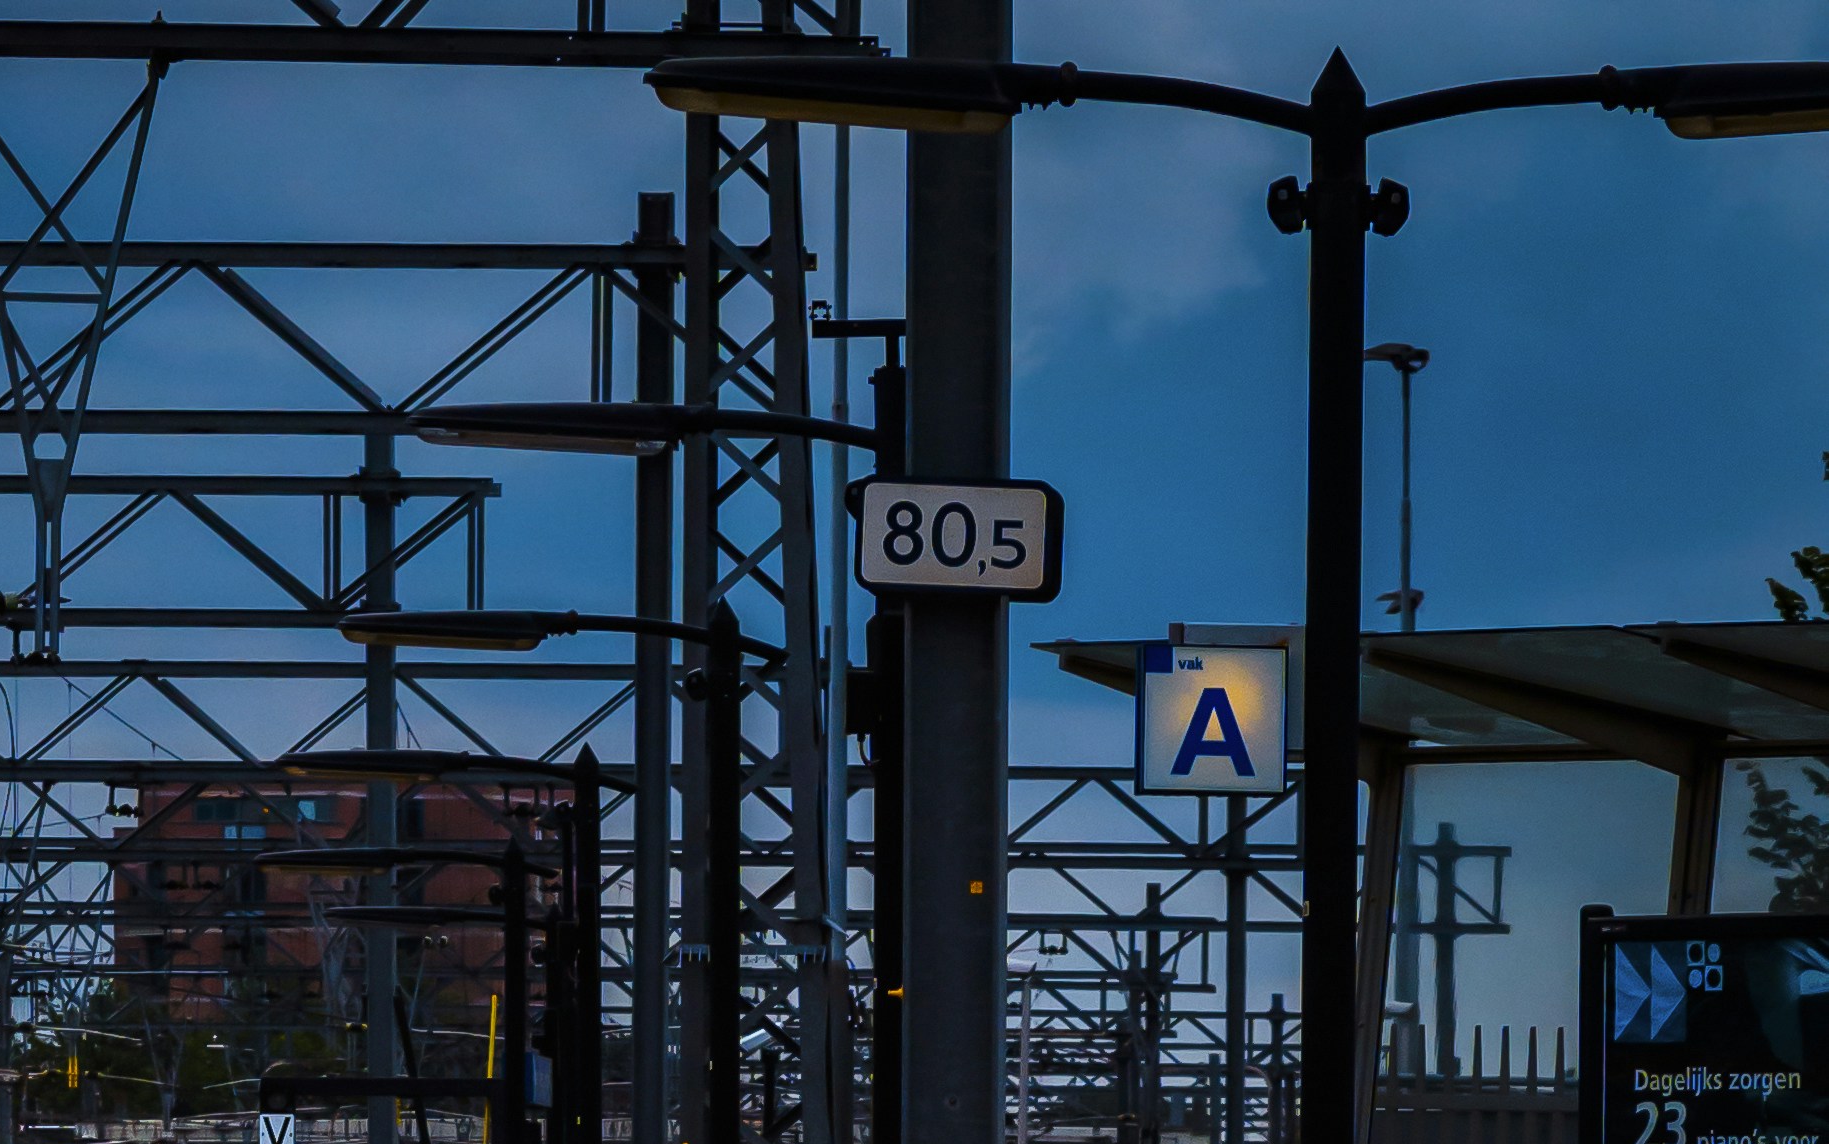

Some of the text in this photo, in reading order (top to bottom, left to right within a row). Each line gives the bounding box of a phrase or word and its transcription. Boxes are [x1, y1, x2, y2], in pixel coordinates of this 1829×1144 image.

[882, 500, 1027, 576] 80,5
[1177, 656, 1204, 670] vak
[1170, 687, 1255, 777] A
[1634, 1066, 1802, 1096] Dagelijks zorgen
